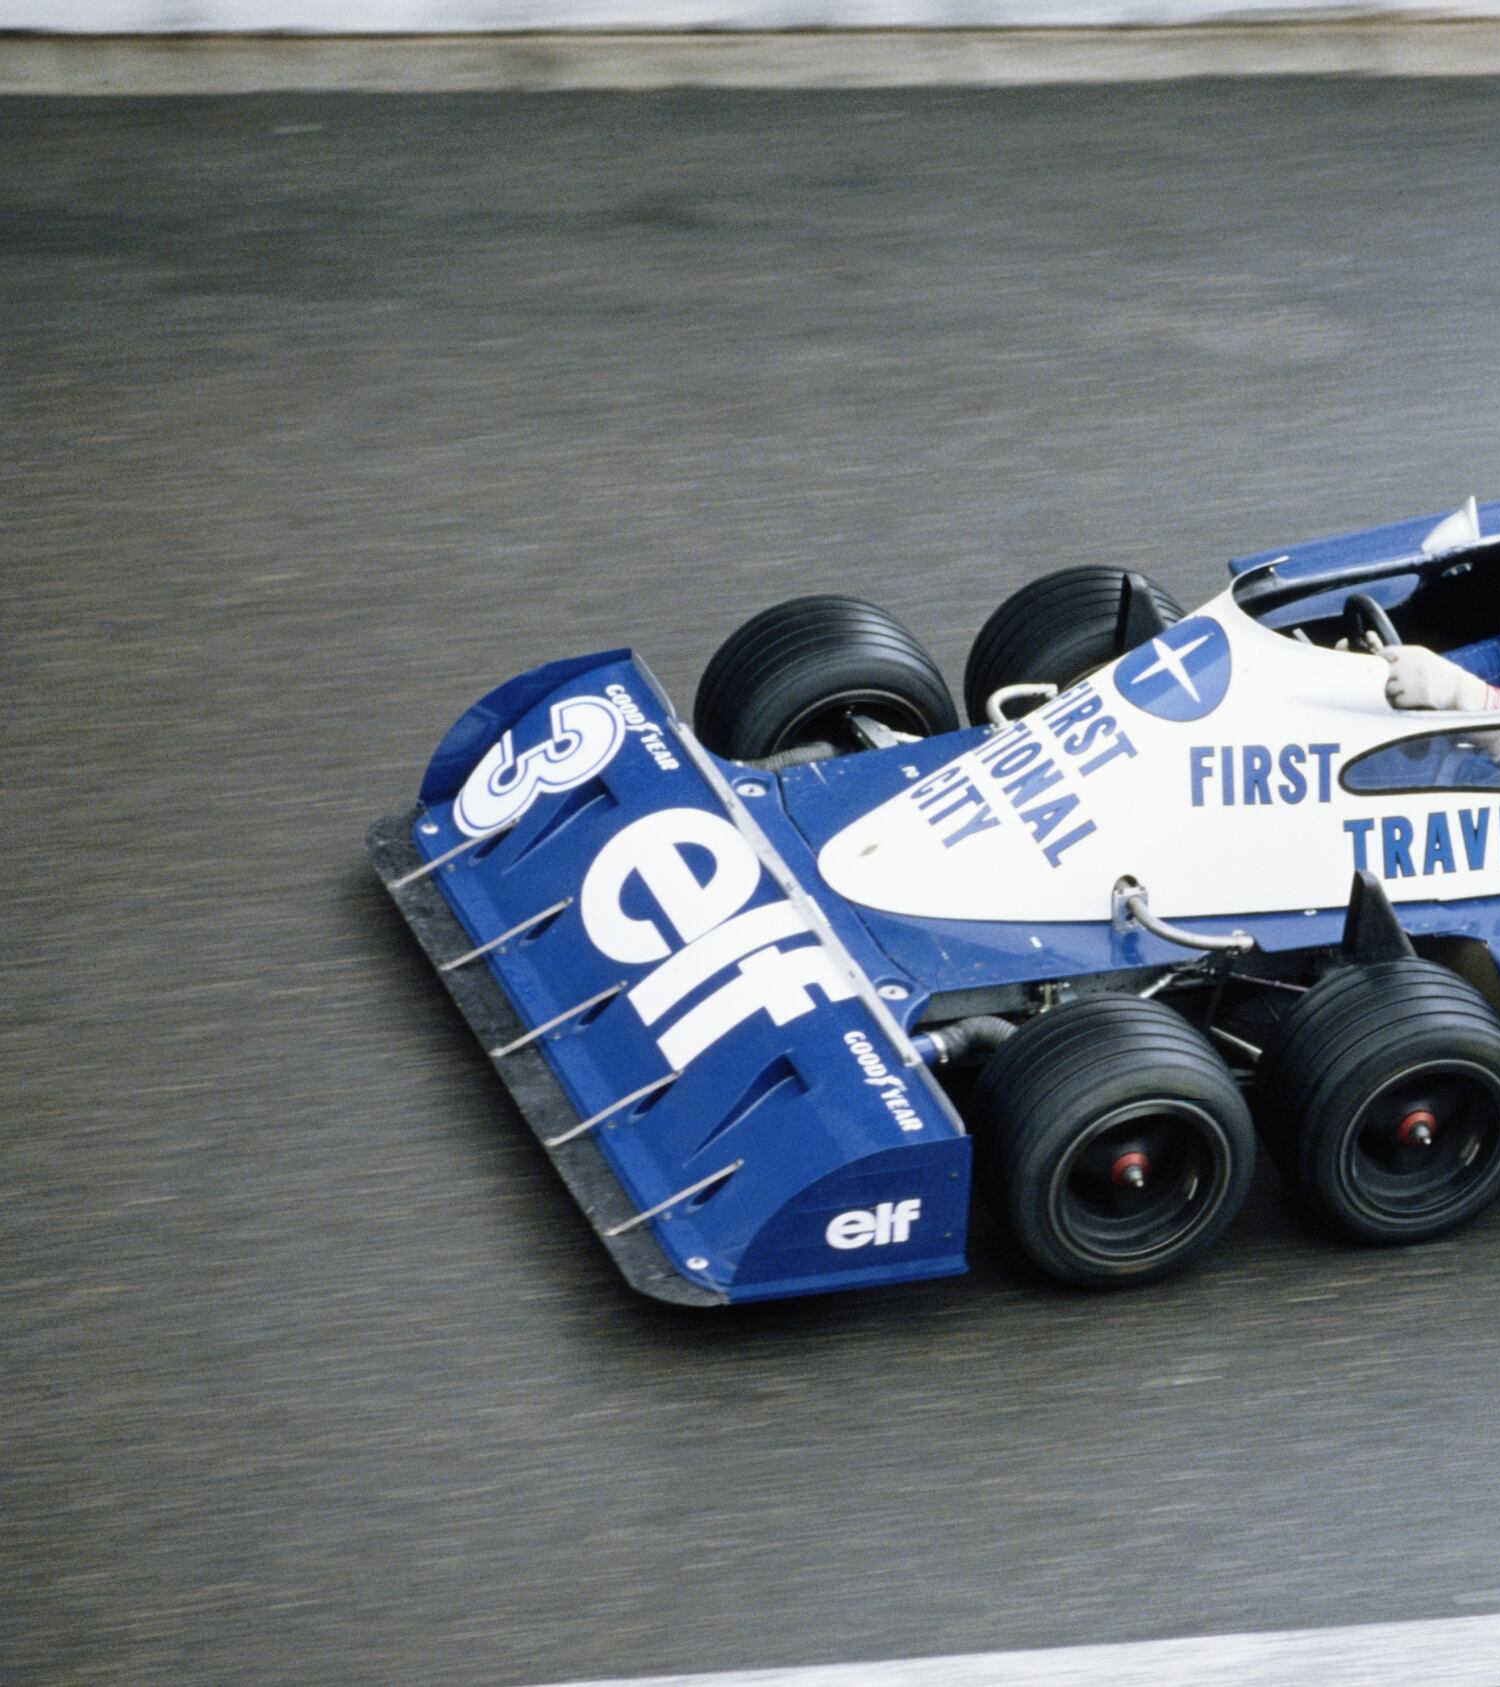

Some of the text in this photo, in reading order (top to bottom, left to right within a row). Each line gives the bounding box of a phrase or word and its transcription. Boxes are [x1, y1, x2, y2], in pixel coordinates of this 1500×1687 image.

[453, 695, 626, 837] 3
[605, 684, 679, 770] GOODYEAR
[910, 766, 1001, 849] CITY
[974, 722, 1098, 869] TIONAL
[1190, 742, 1340, 806] FIRST
[580, 808, 862, 1072] elf
[843, 1031, 924, 1131] GOODYEAR
[826, 1200, 921, 1250] elf
